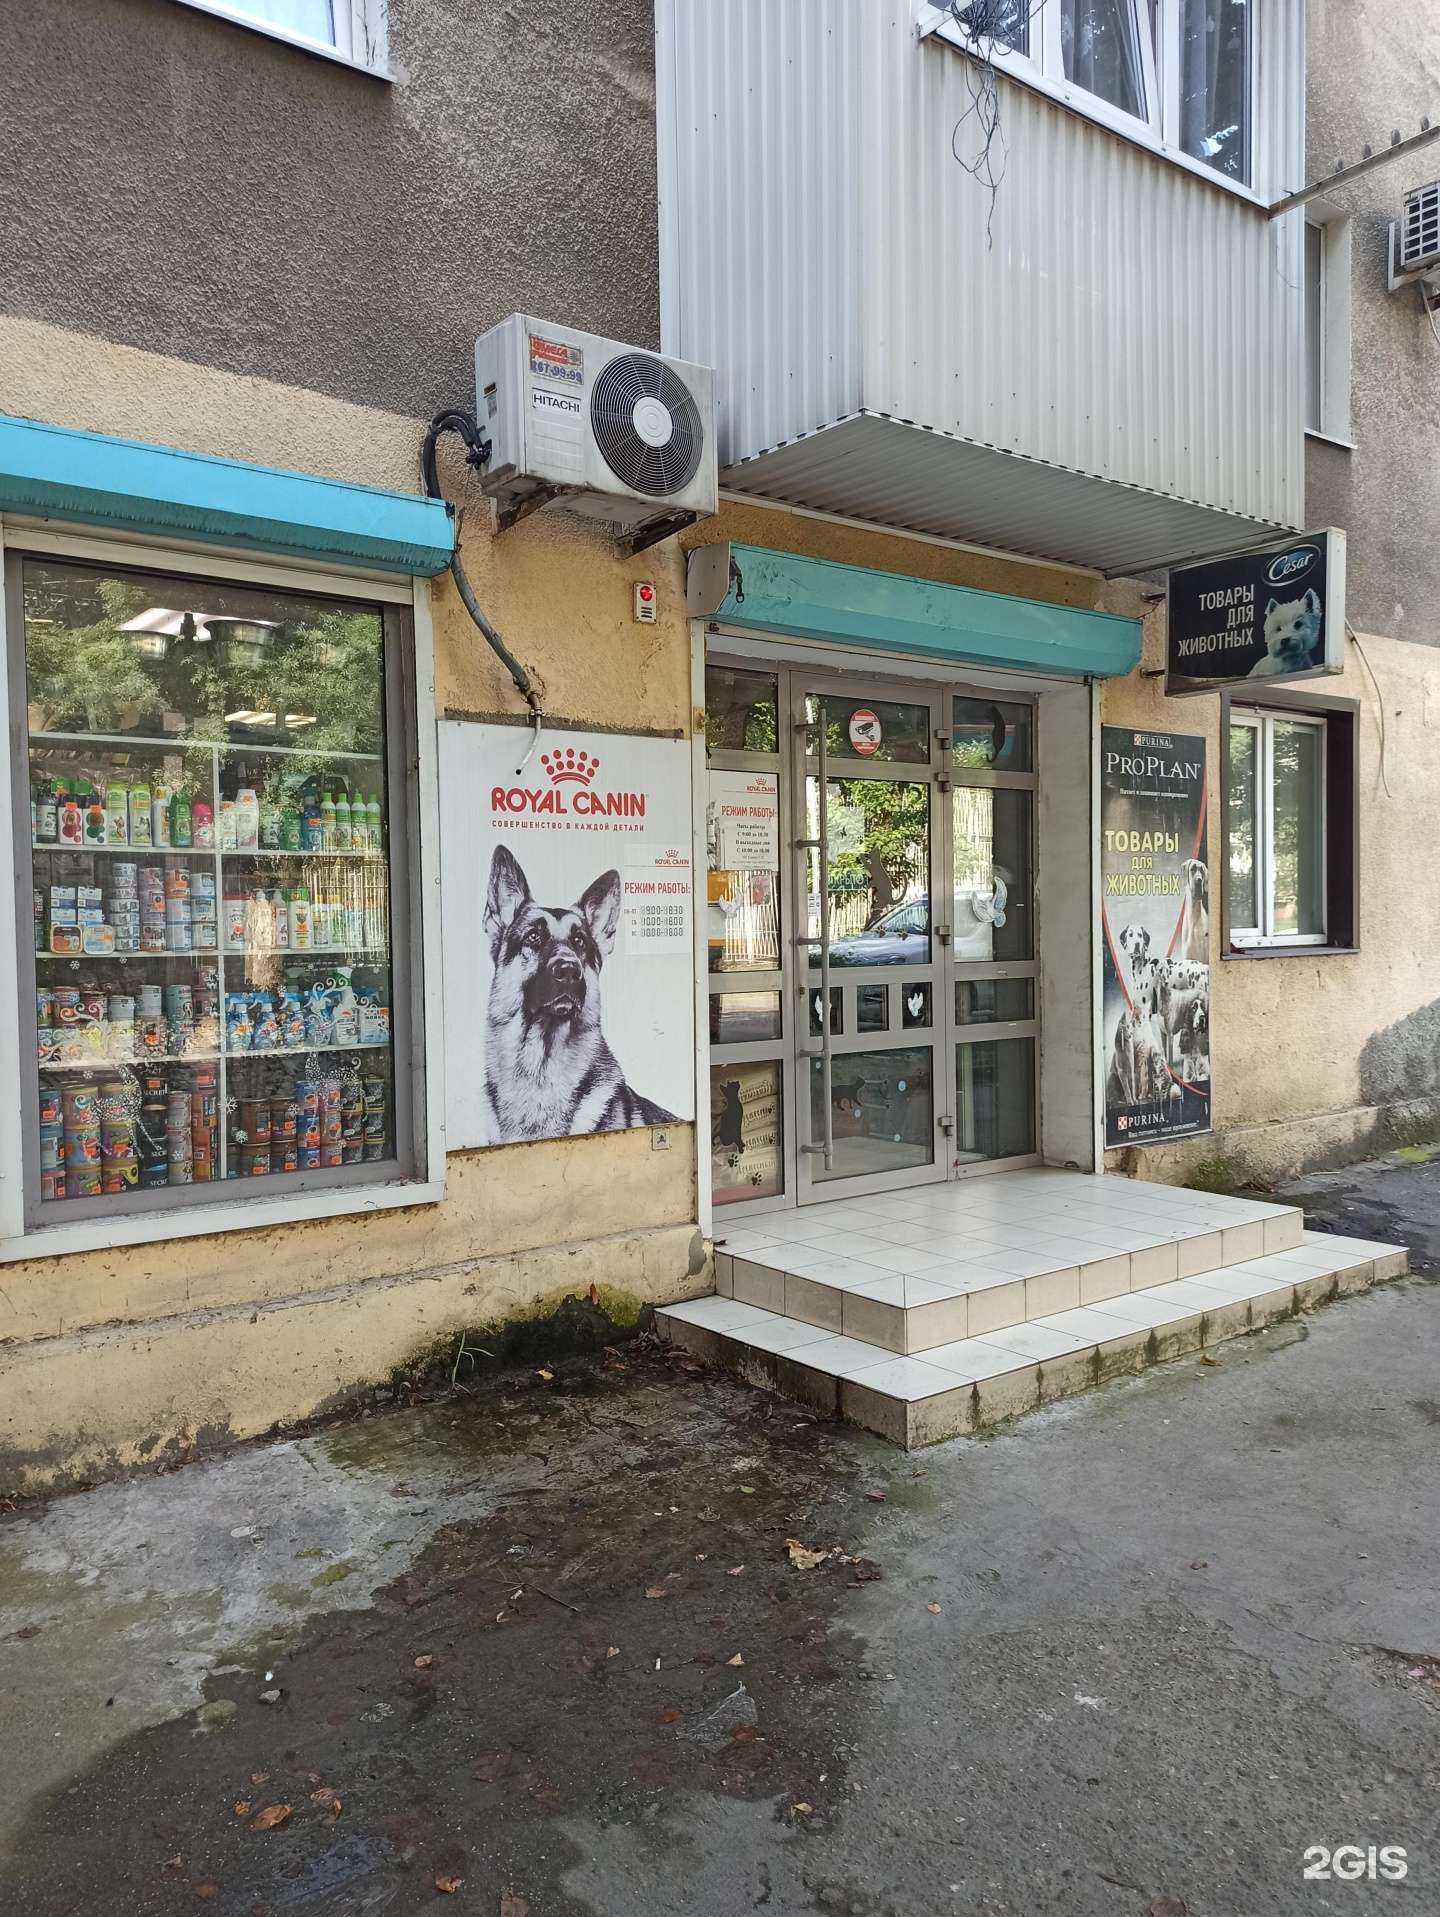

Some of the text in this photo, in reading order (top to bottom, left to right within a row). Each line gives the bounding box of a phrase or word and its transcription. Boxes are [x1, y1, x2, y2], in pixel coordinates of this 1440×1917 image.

[533, 393, 580, 413] HITACHI
[1268, 553, 1314, 581] Cesar
[1198, 584, 1255, 611] ТОВАРЫ
[1226, 605, 1254, 629] ДЛЯ
[1178, 627, 1254, 657] ЖИВОТНЫХ
[1141, 736, 1170, 747] PURINA
[491, 786, 646, 817] ROYAL CANIN
[721, 805, 748, 817] РЕЖИМ
[491, 820, 644, 832] СОВЕРШЕНСТВО В КАЖДОЙ ДЕТАЛИ
[1105, 830, 1179, 853] ТОВАРЫ
[624, 882, 655, 894] РЕЖИМ
[1106, 874, 1180, 897] ЖИВОТНЫХ
[1128, 1113, 1165, 1128] PURINA
